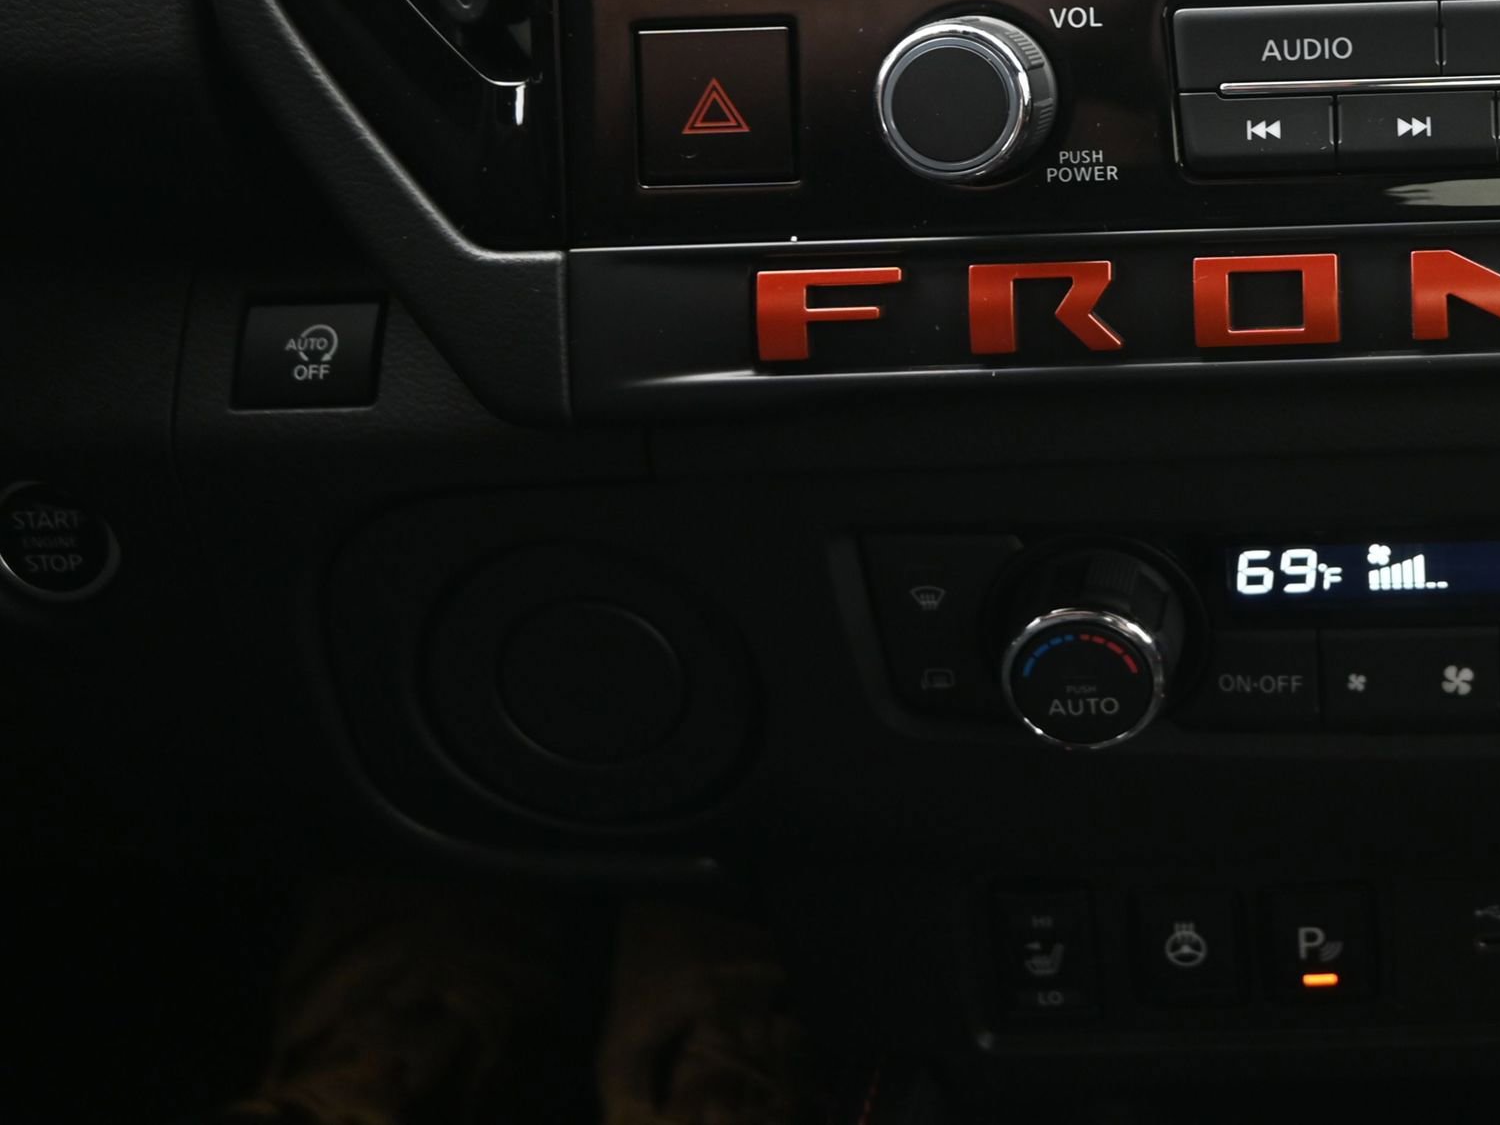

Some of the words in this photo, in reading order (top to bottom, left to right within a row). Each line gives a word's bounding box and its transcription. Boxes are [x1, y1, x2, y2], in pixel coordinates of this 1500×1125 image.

[1048, 6, 1103, 29] VOL
[1261, 36, 1353, 62] AUDIO
[1059, 149, 1104, 164] PUSH
[1046, 165, 1119, 183] POWER
[284, 338, 328, 351] AUTO
[293, 364, 331, 381] OFF
[11, 508, 81, 529] START
[21, 535, 79, 549] ENGINE
[23, 554, 84, 572] STOP
[1066, 685, 1097, 695] PUSH
[1048, 696, 1120, 716] AUTO
[1038, 991, 1065, 1007] LO
